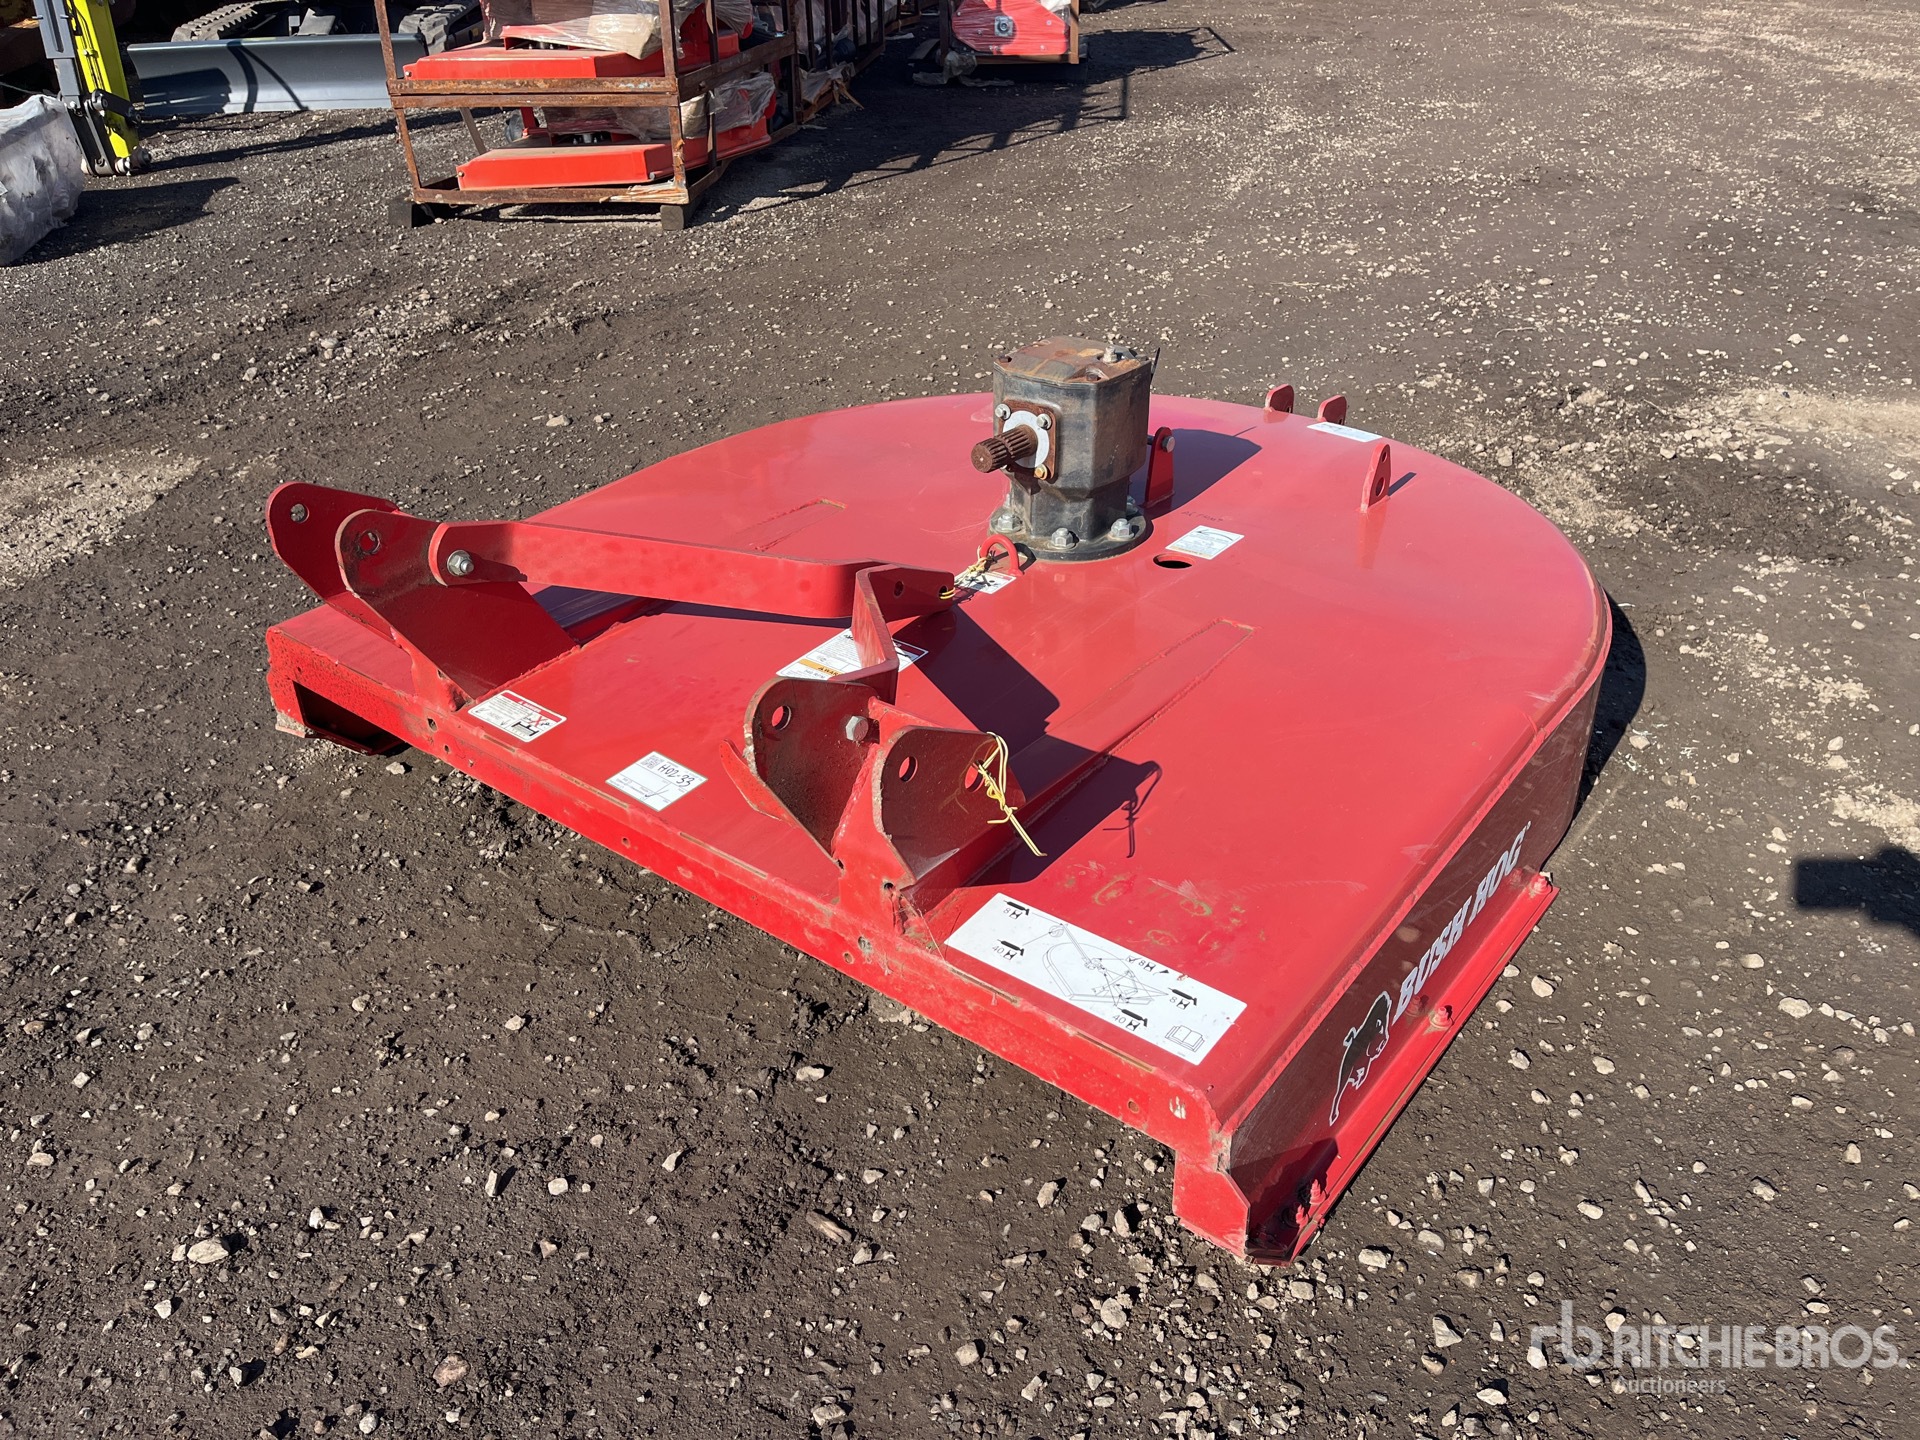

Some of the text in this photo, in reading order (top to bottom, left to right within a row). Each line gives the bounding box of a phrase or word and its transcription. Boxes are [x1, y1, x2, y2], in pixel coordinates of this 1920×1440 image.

[658, 764, 695, 788] H02-33
[1003, 907, 1010, 915] 8
[1392, 826, 1526, 1026] BUSH HOG
[992, 945, 1005, 954] 40
[1138, 959, 1146, 967] 8
[1170, 995, 1177, 1004] 8
[1112, 1013, 1126, 1024] 40
